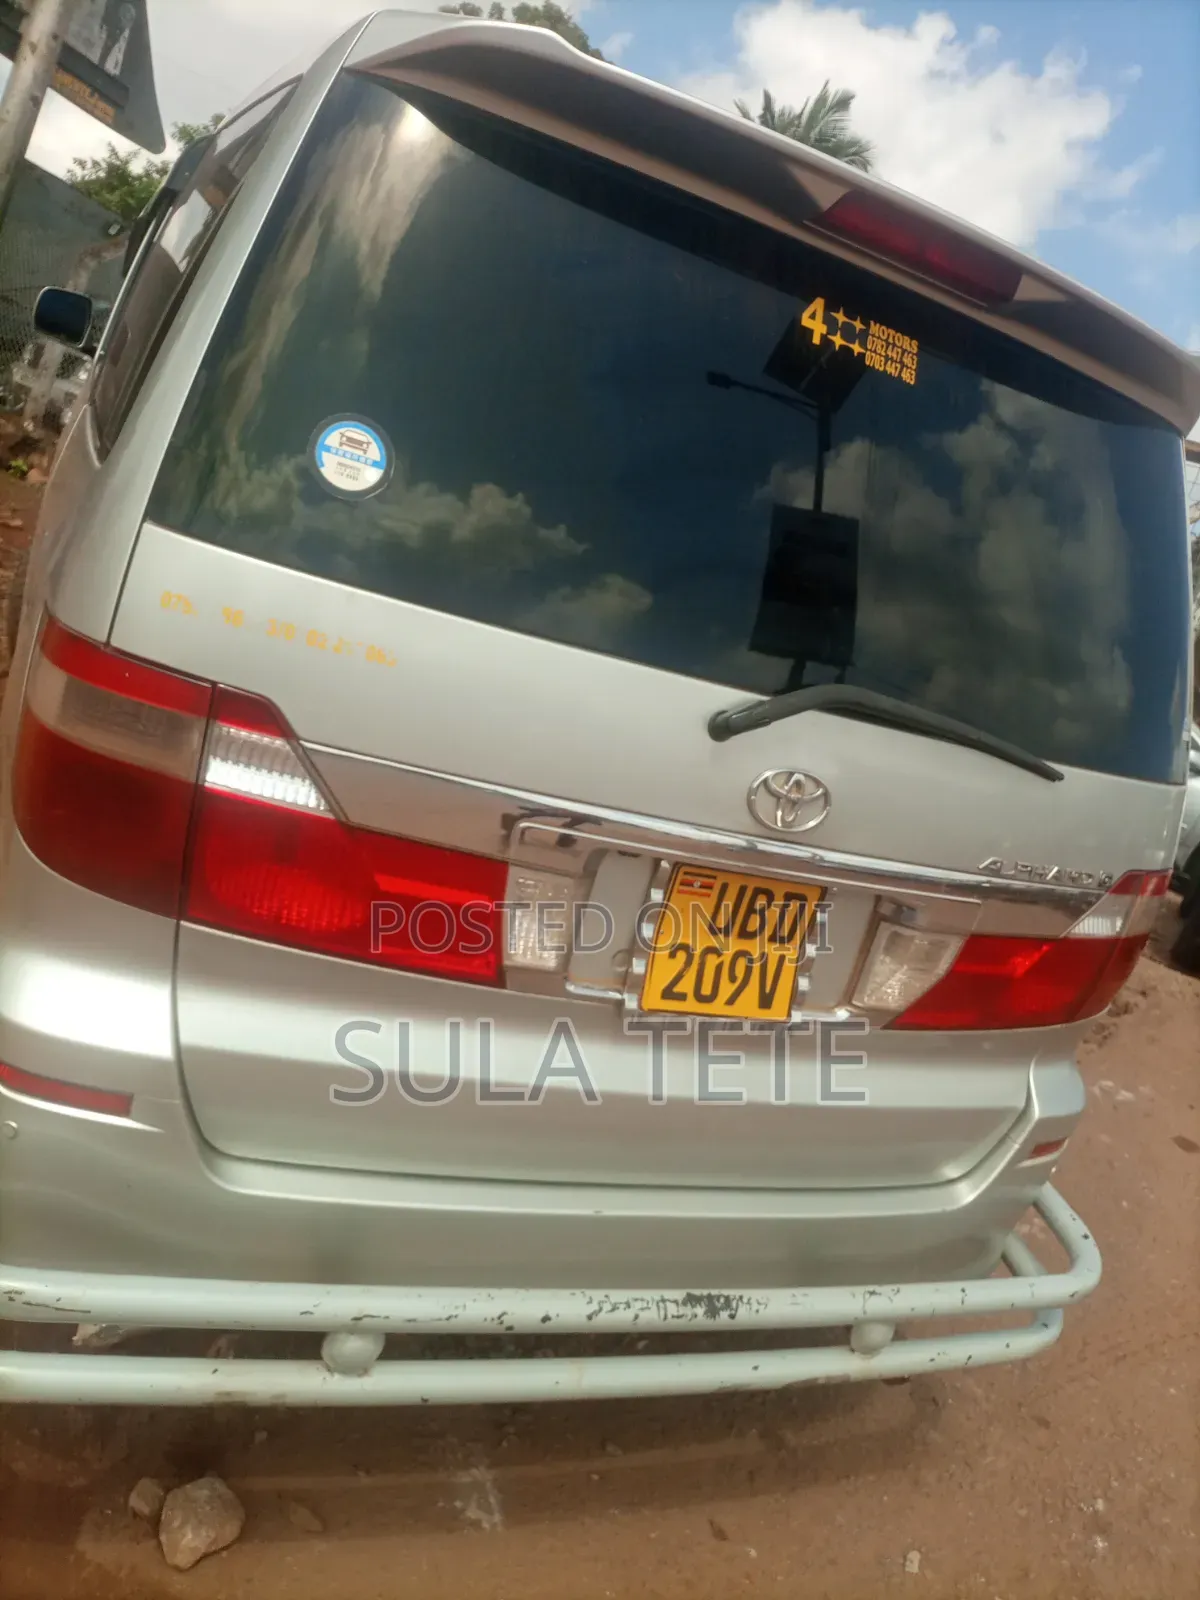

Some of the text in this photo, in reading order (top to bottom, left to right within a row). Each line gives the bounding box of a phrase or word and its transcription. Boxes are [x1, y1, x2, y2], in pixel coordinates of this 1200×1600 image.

[801, 297, 828, 345] 4
[869, 320, 918, 354] MOTORS
[864, 352, 916, 385] 0703 447 463
[866, 335, 918, 370] 0782 447 463
[708, 881, 809, 944] UBD
[660, 941, 787, 1010] 209V
